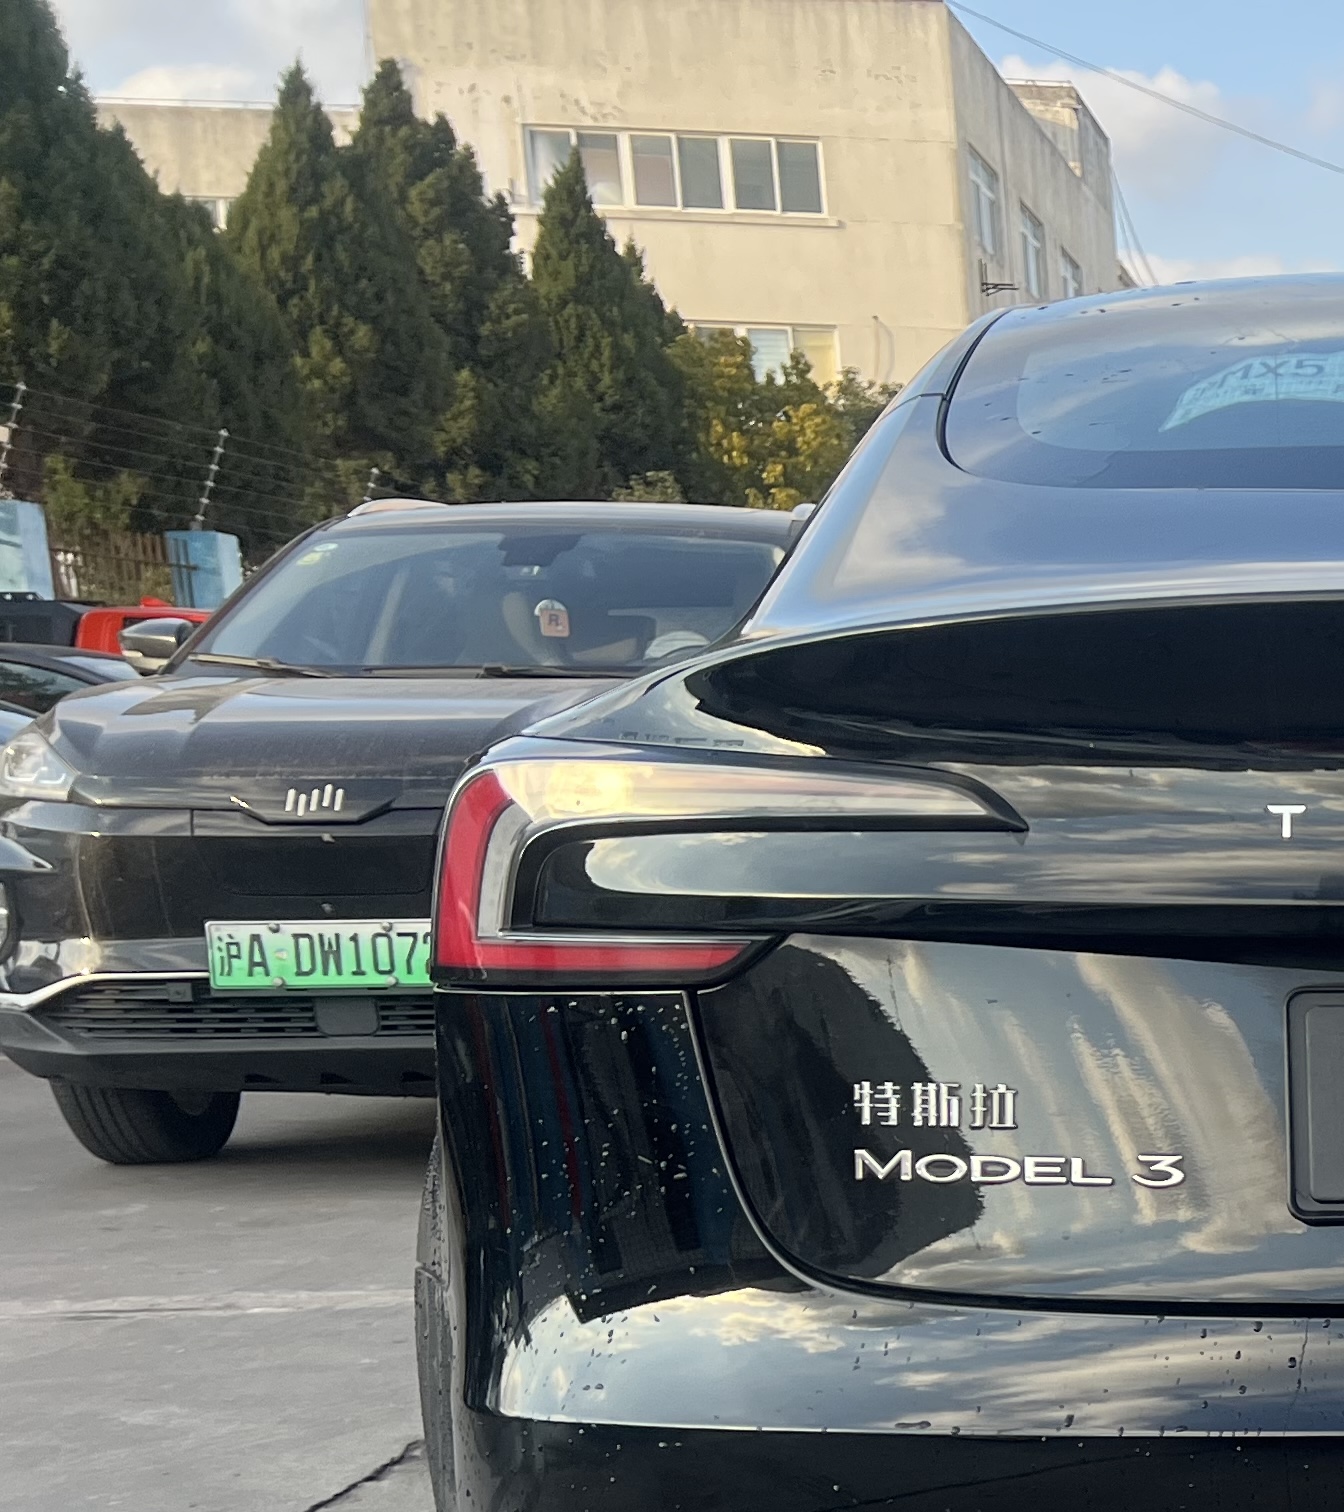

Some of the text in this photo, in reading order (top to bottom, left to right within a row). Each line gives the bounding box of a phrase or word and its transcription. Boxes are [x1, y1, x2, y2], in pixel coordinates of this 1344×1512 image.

[853, 1080, 1019, 1129] 特斯拉
[853, 1148, 1186, 1188] MODEL 3
